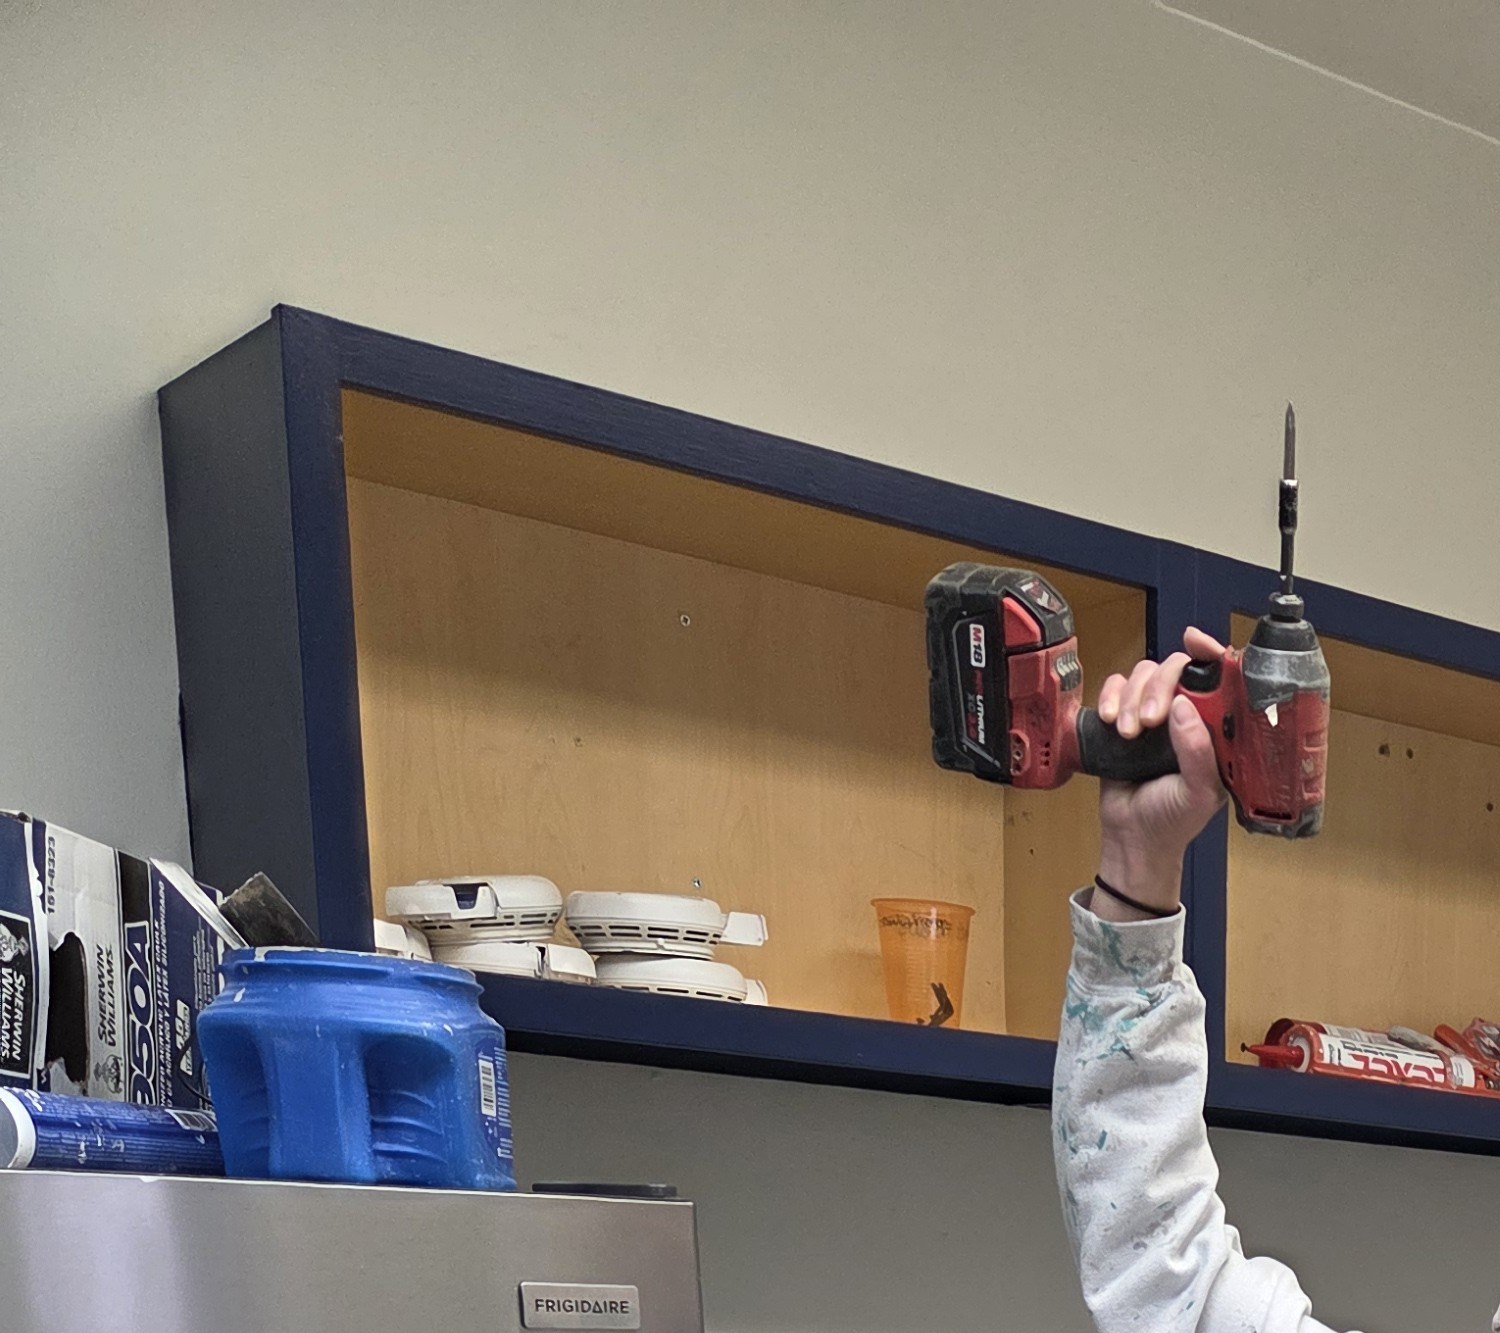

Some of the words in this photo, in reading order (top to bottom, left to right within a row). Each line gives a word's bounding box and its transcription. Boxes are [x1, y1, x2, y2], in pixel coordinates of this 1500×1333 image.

[973, 627, 983, 664] M18
[0, 967, 14, 1060] WILLIAMS
[12, 970, 26, 1061] SHERWIN
[97, 944, 105, 1042] SHERWIN
[105, 944, 117, 1048] WILLIAMS
[124, 920, 156, 1106] 950A
[535, 1299, 630, 1314] FRIGIDAIRE
